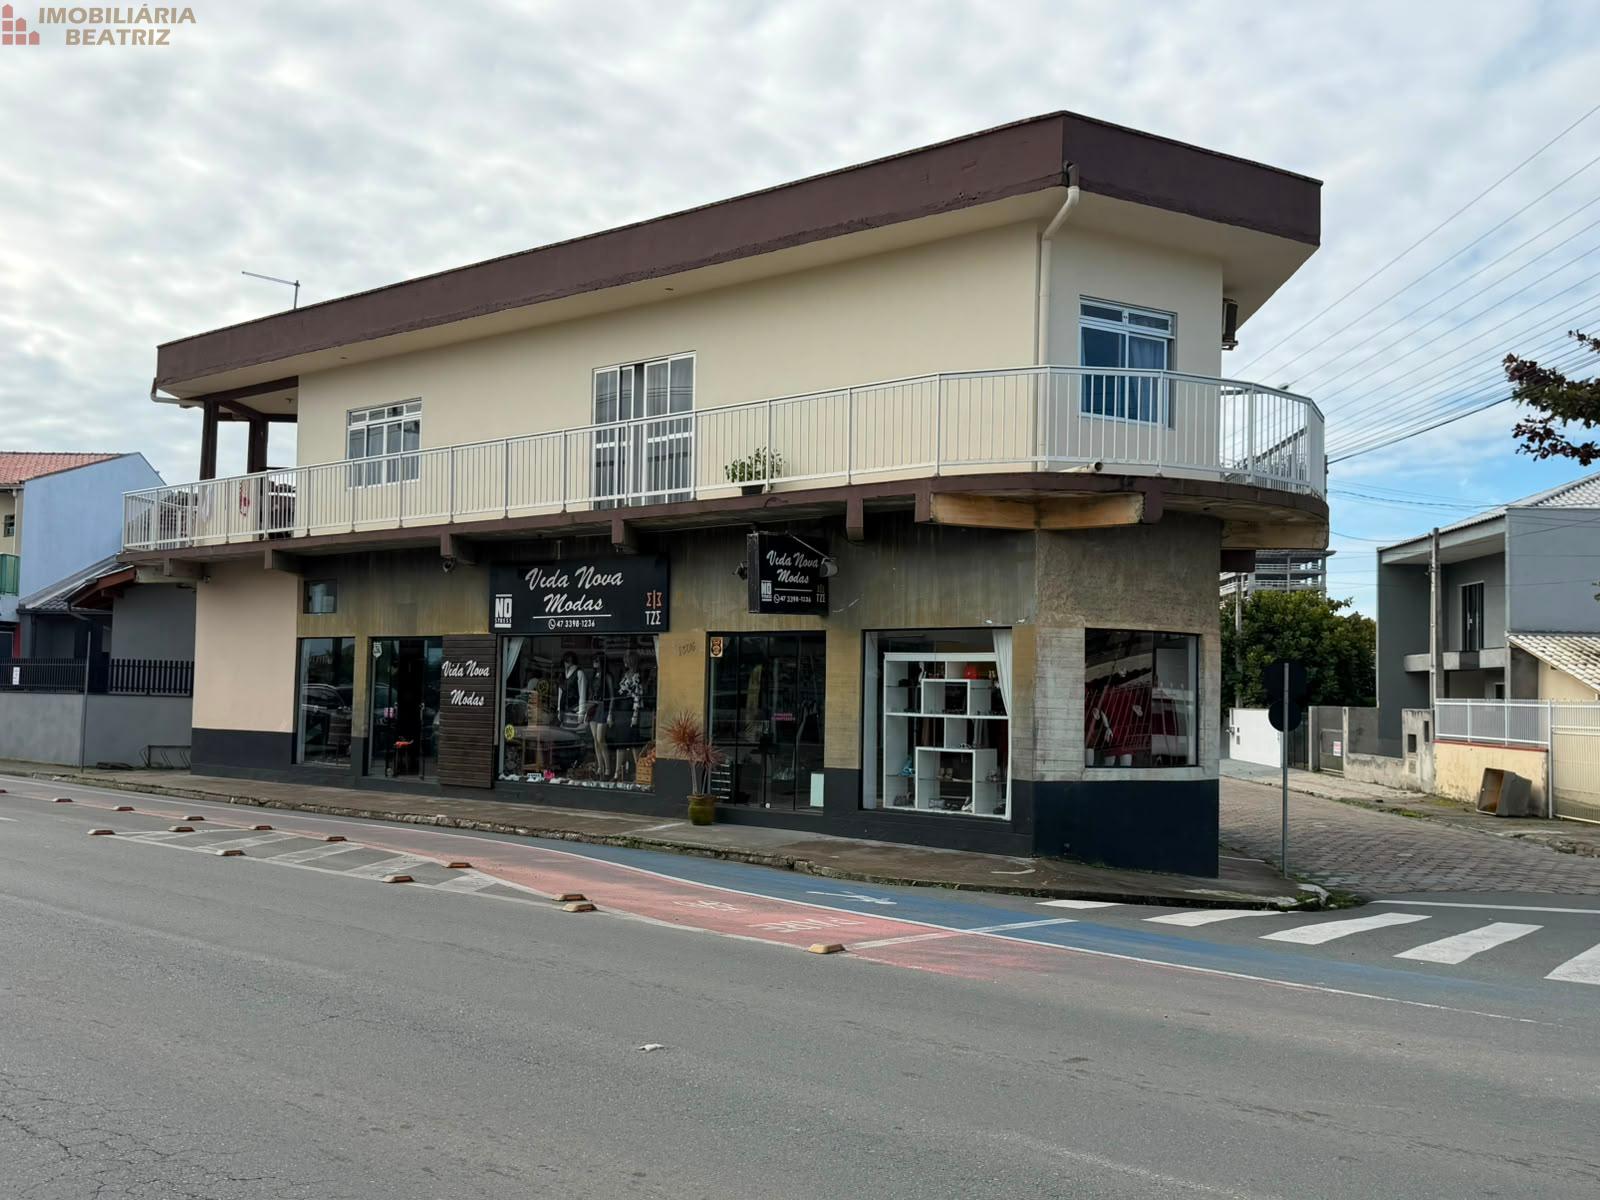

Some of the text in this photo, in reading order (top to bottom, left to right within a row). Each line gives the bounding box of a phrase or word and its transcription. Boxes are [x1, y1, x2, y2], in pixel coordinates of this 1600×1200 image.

[766, 550, 819, 568] Vida Nova
[525, 566, 624, 591] Vida Nova
[776, 568, 809, 584] Modas
[495, 598, 512, 618] NO
[543, 593, 603, 614] Modas
[556, 620, 564, 628] 47
[441, 660, 490, 677] Vida Nova
[450, 689, 484, 706] Modas
